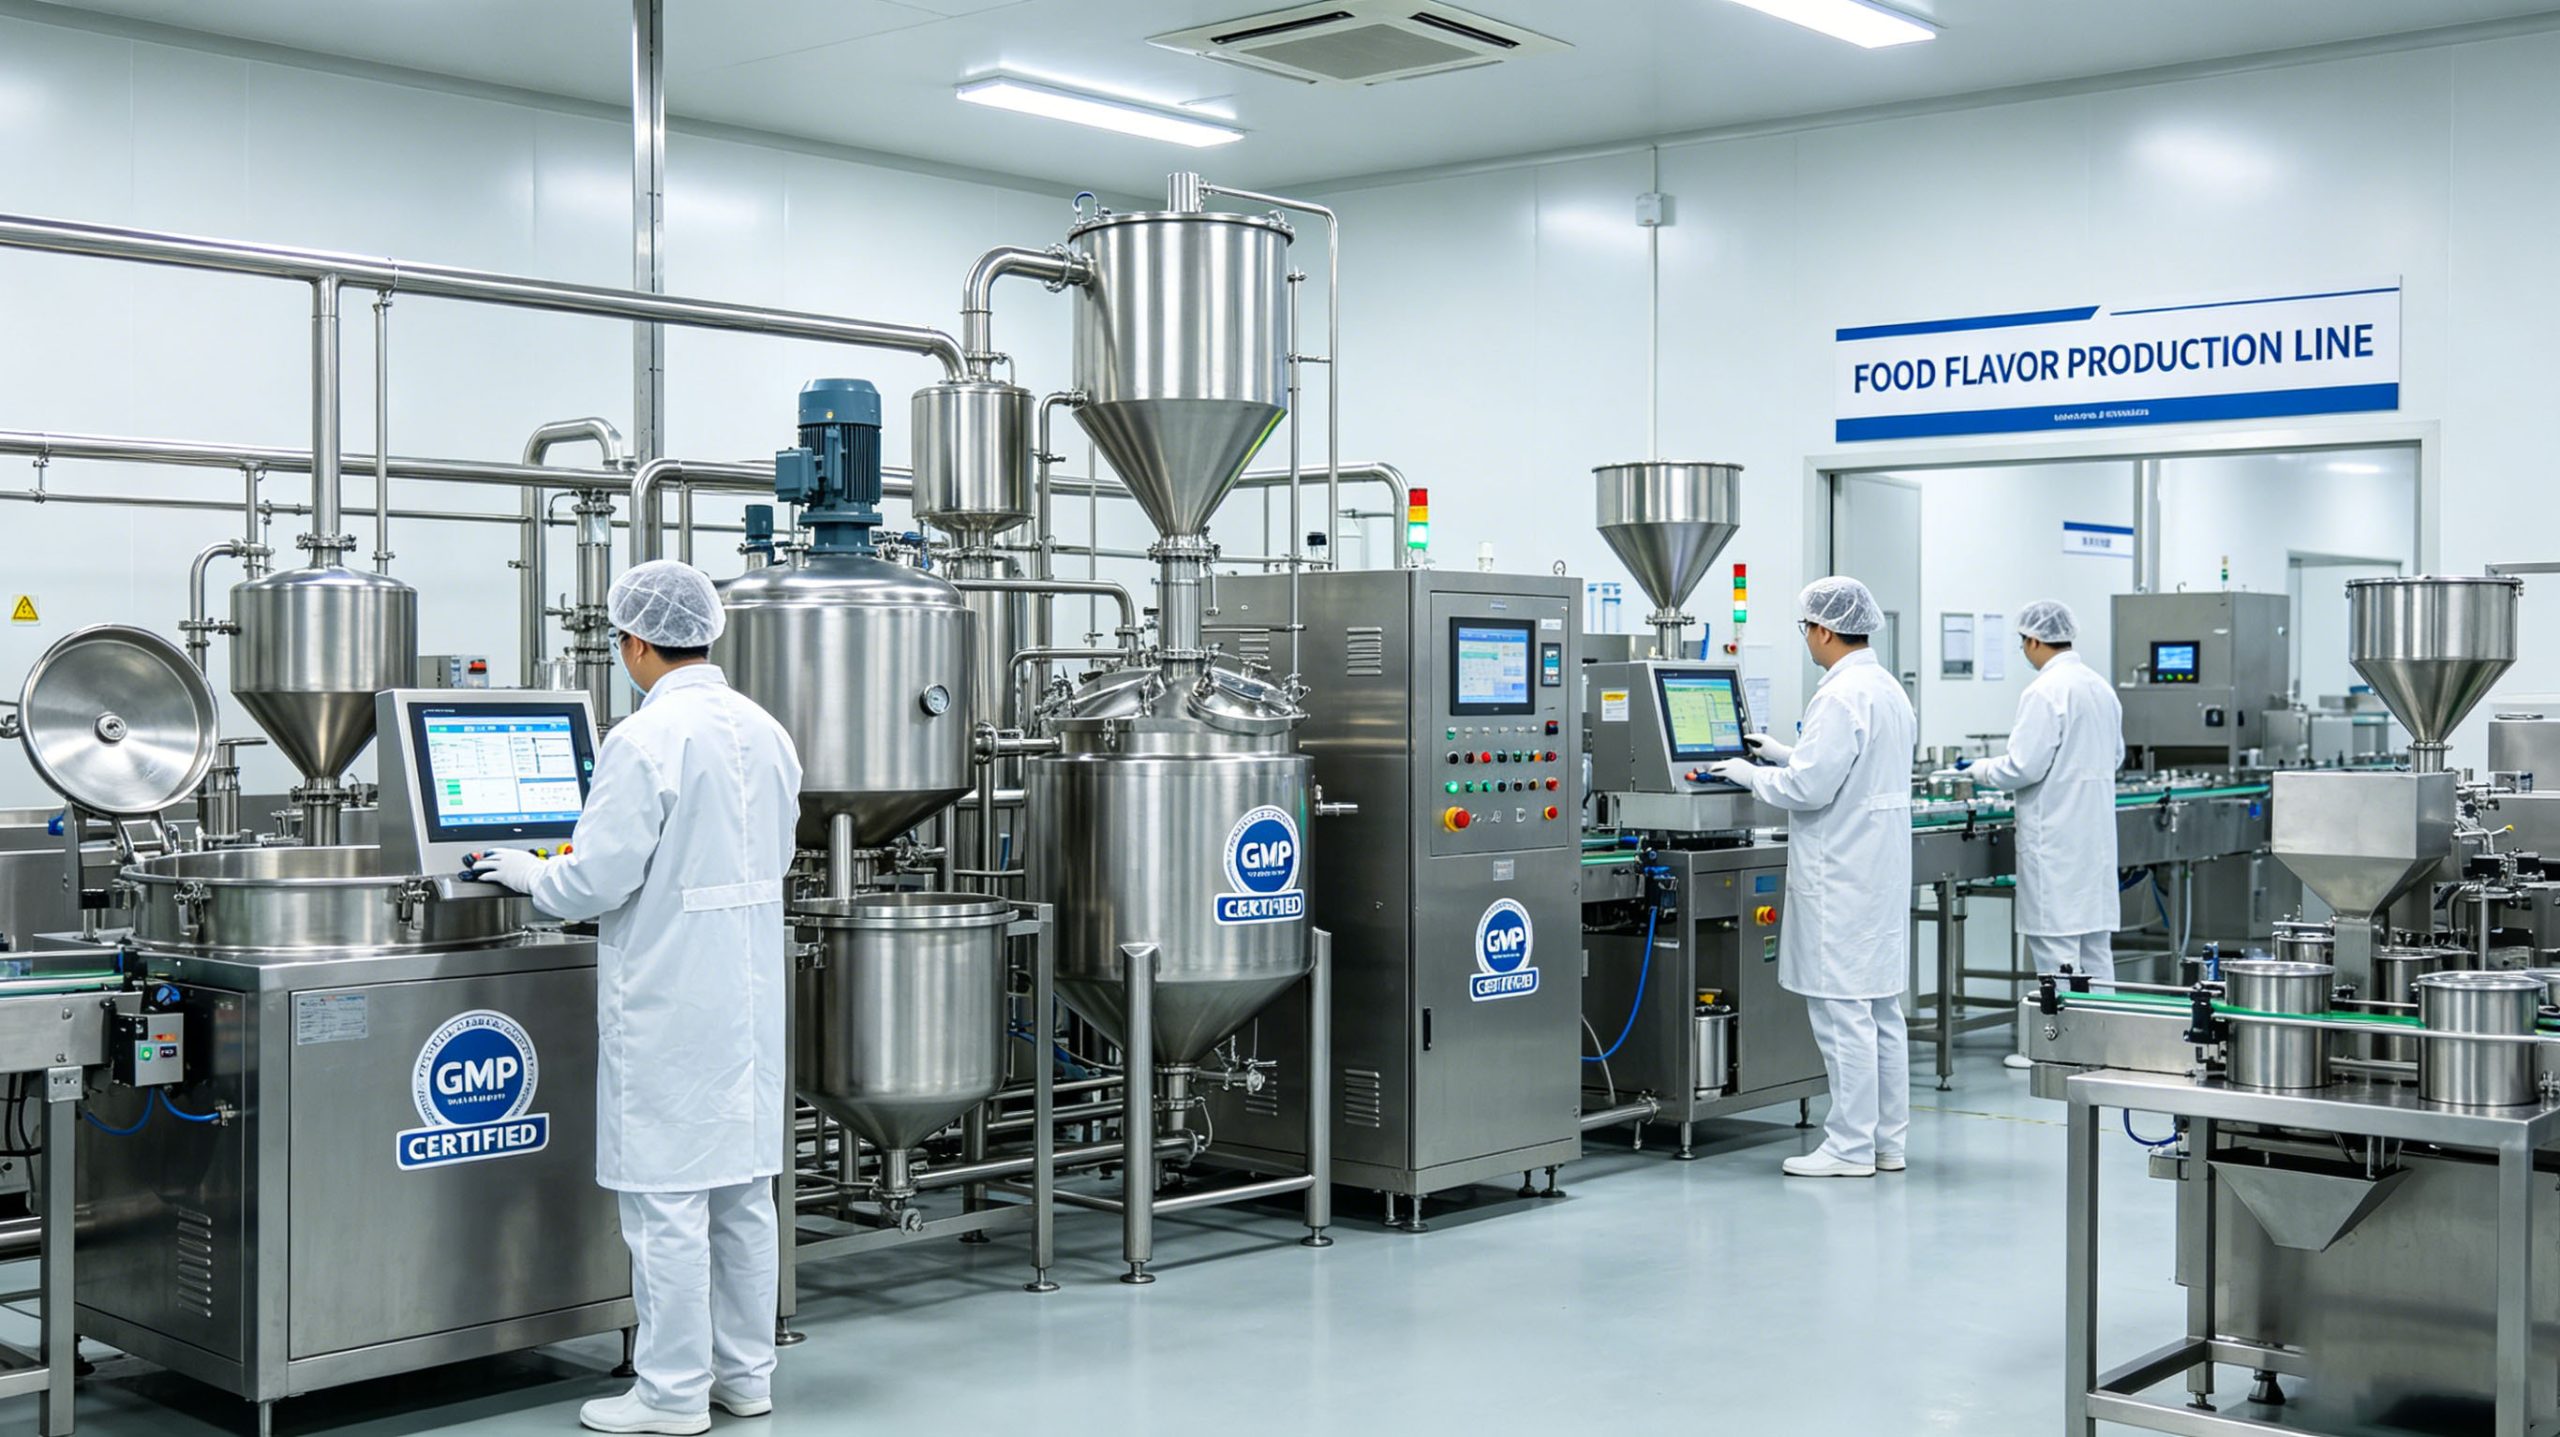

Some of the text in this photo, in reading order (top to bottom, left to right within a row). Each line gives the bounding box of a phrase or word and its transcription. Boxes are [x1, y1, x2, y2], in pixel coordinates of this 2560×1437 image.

[1854, 323, 2374, 394] FOOD FLAVOR PRODUCTION LINE
[1241, 840, 1292, 869] GMP
[436, 1056, 519, 1096] GMP
[408, 1123, 538, 1160] CERTIFIED
